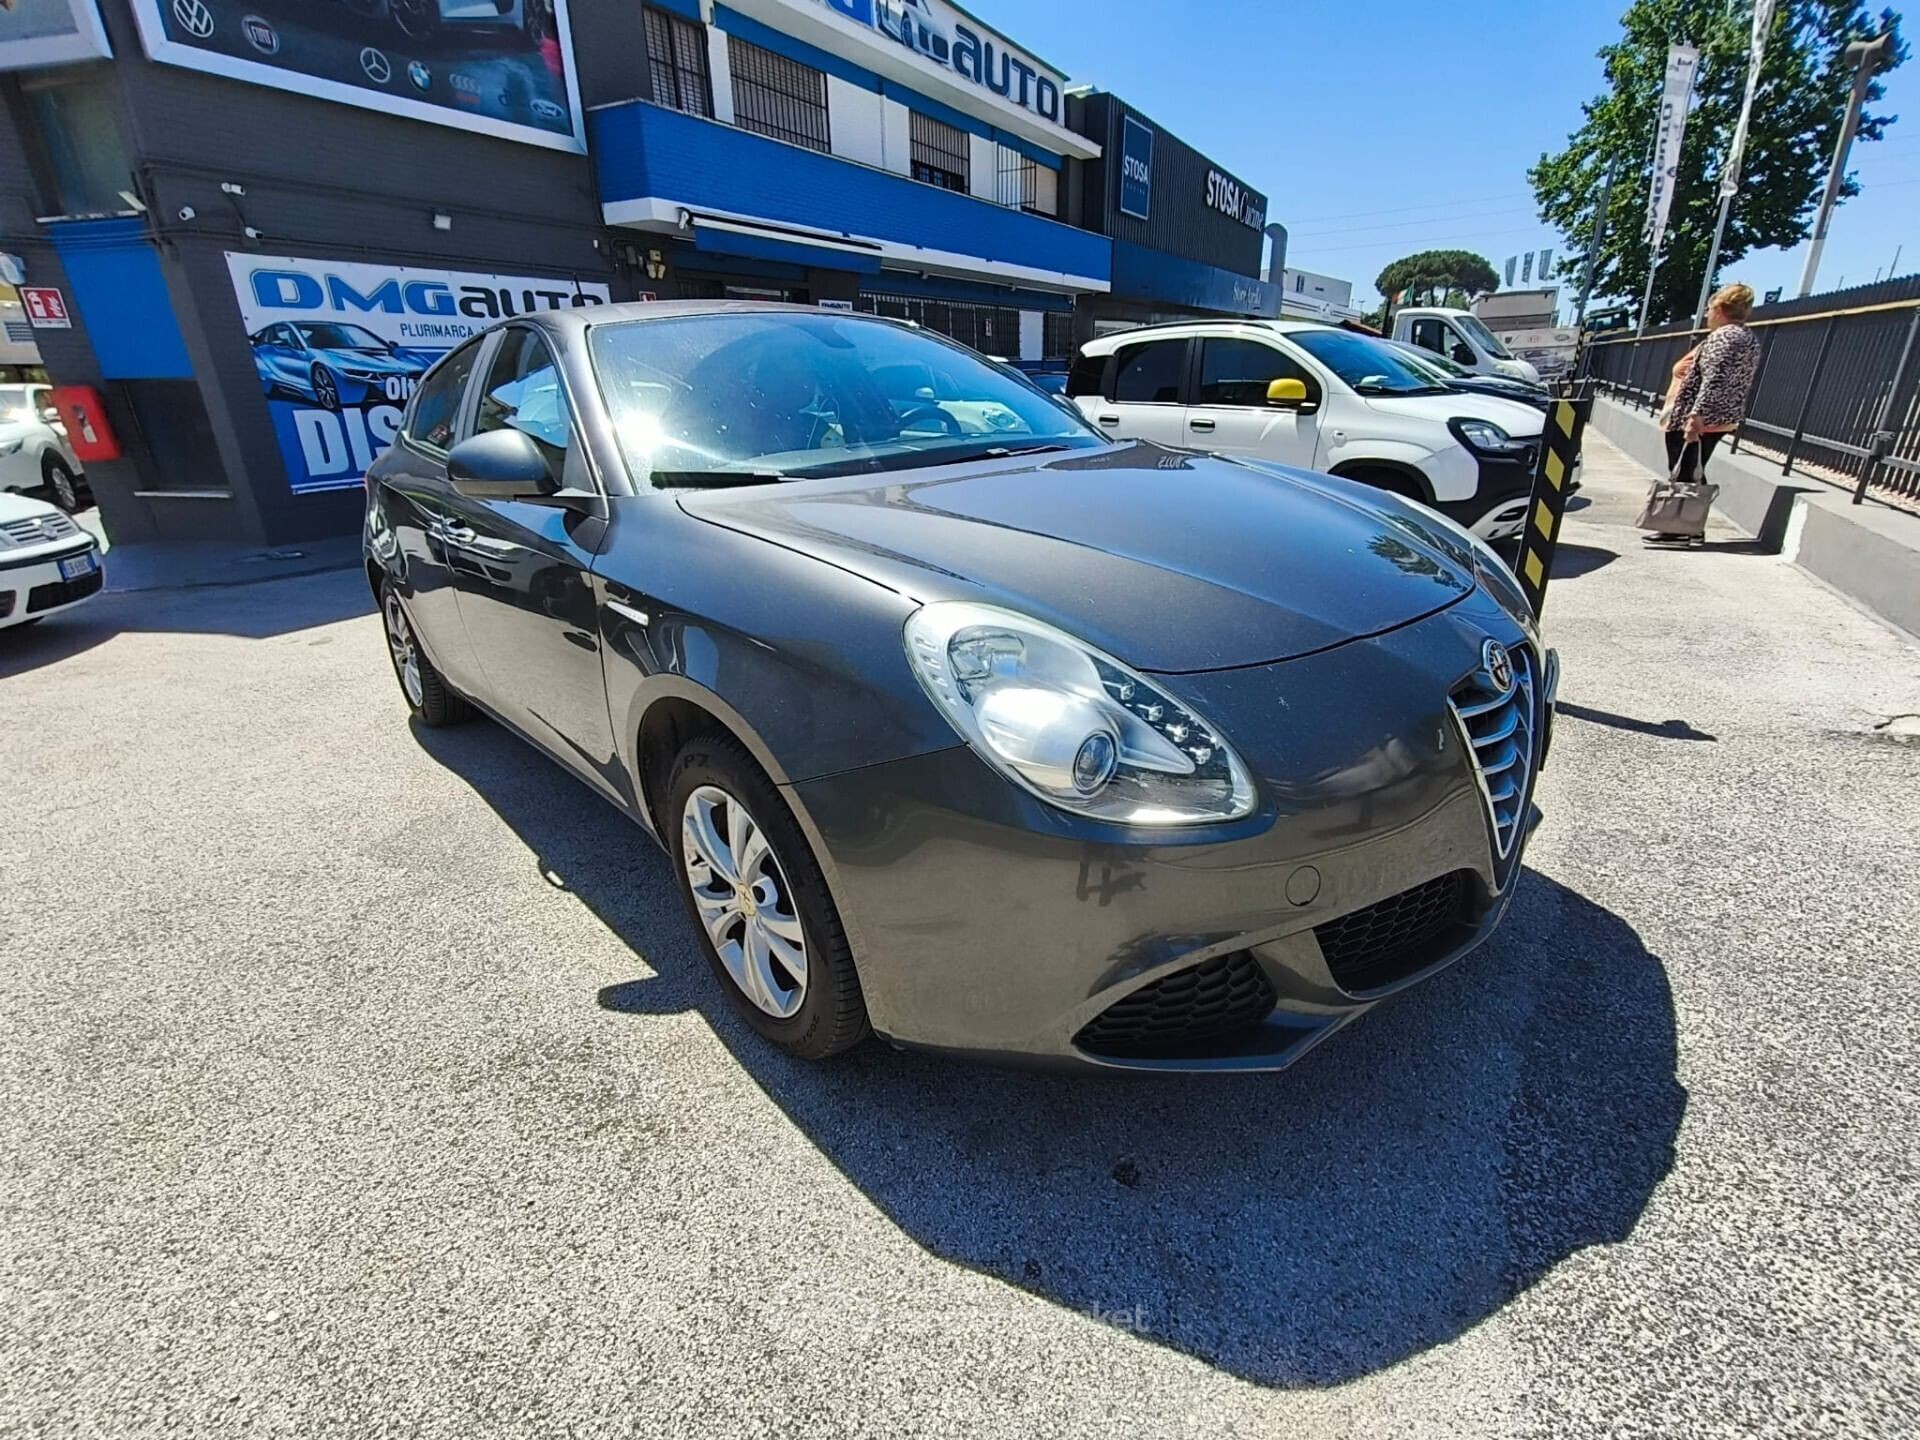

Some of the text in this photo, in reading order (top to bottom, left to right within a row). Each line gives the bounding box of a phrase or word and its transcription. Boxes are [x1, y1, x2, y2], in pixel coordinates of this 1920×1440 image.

[1124, 155, 1149, 185] STOSA
[1206, 169, 1240, 220] STOSA
[400, 322, 475, 339] PLURIMARCA
